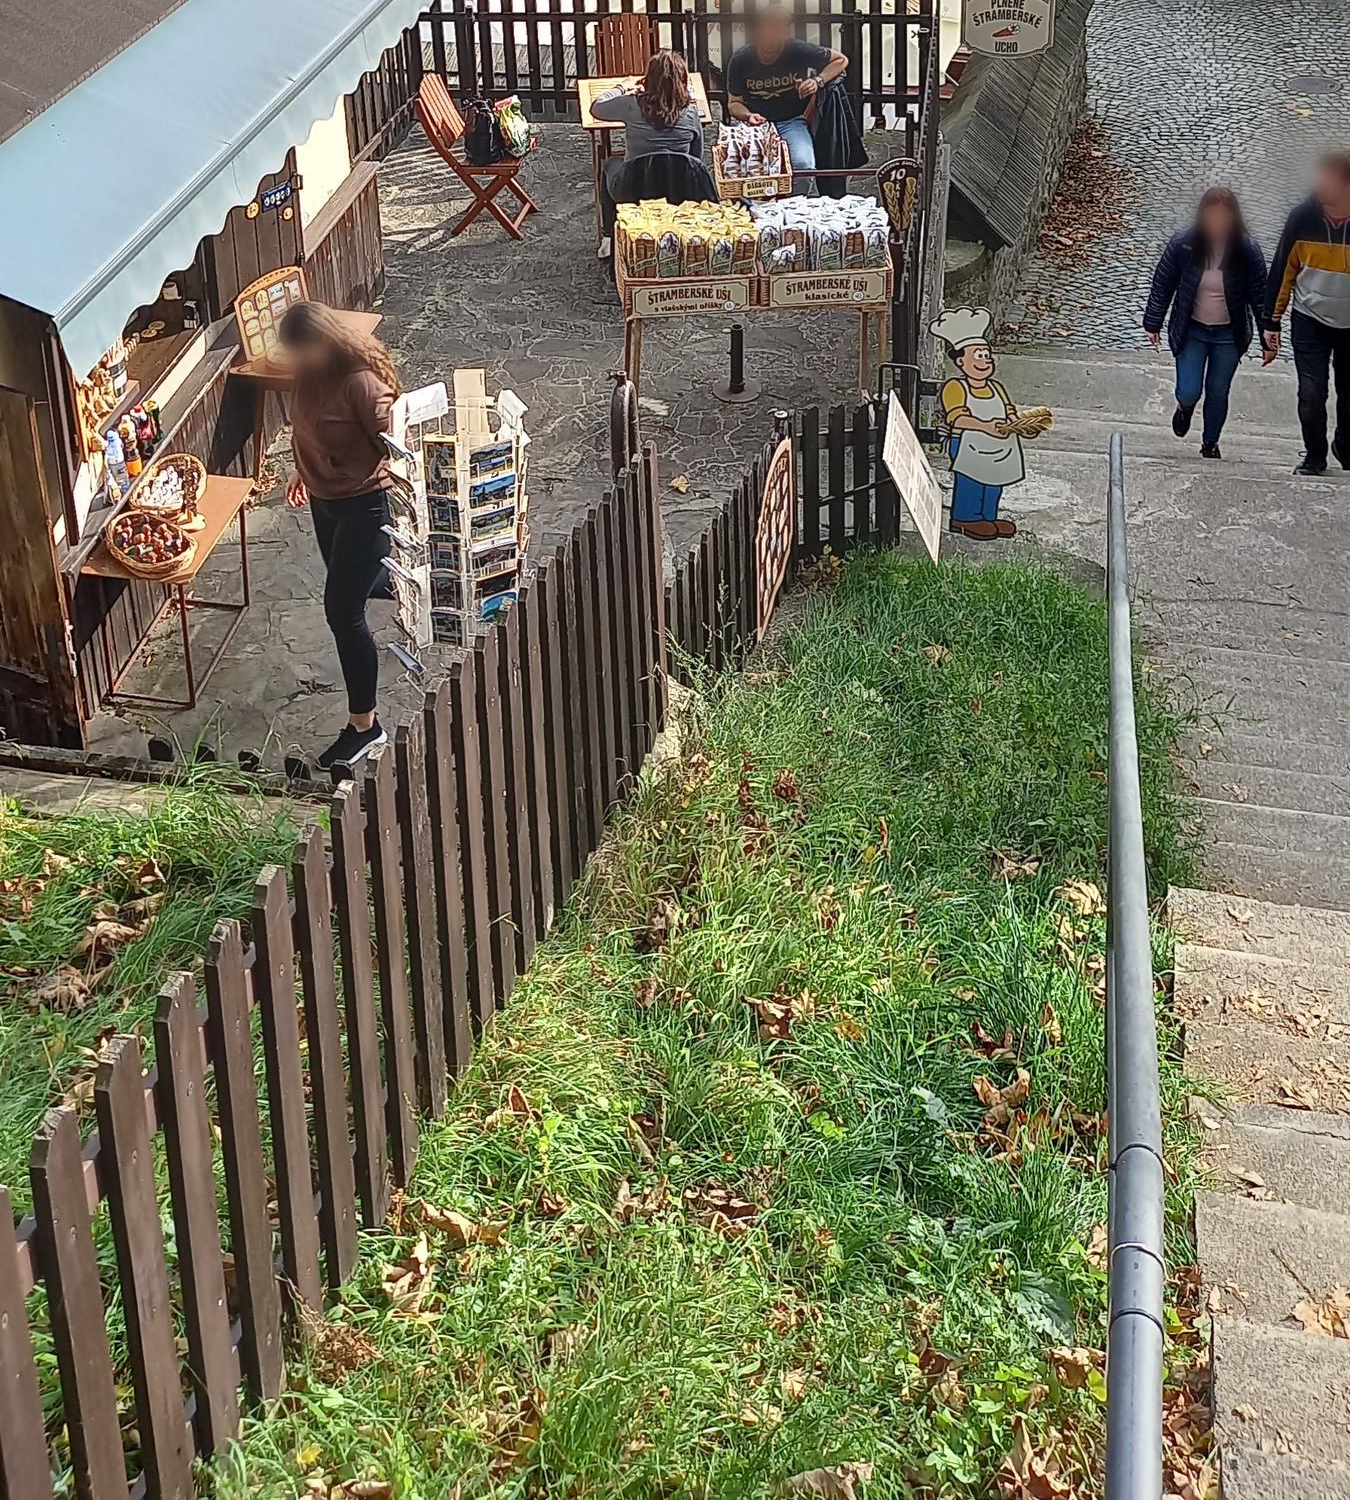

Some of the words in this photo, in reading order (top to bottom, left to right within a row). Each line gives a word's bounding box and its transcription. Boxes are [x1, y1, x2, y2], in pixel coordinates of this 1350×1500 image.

[972, 9, 1043, 29] ŠTRAMBERSKÉ
[994, 41, 1018, 53] UCHO
[890, 168, 906, 181] 10
[785, 275, 851, 296] ŠTRAMBERSKÉ
[853, 277, 868, 292] UŠI
[647, 285, 714, 306] ŠTRAMBERSKÉ
[716, 285, 732, 301] UŠI
[805, 290, 849, 301] klasické
